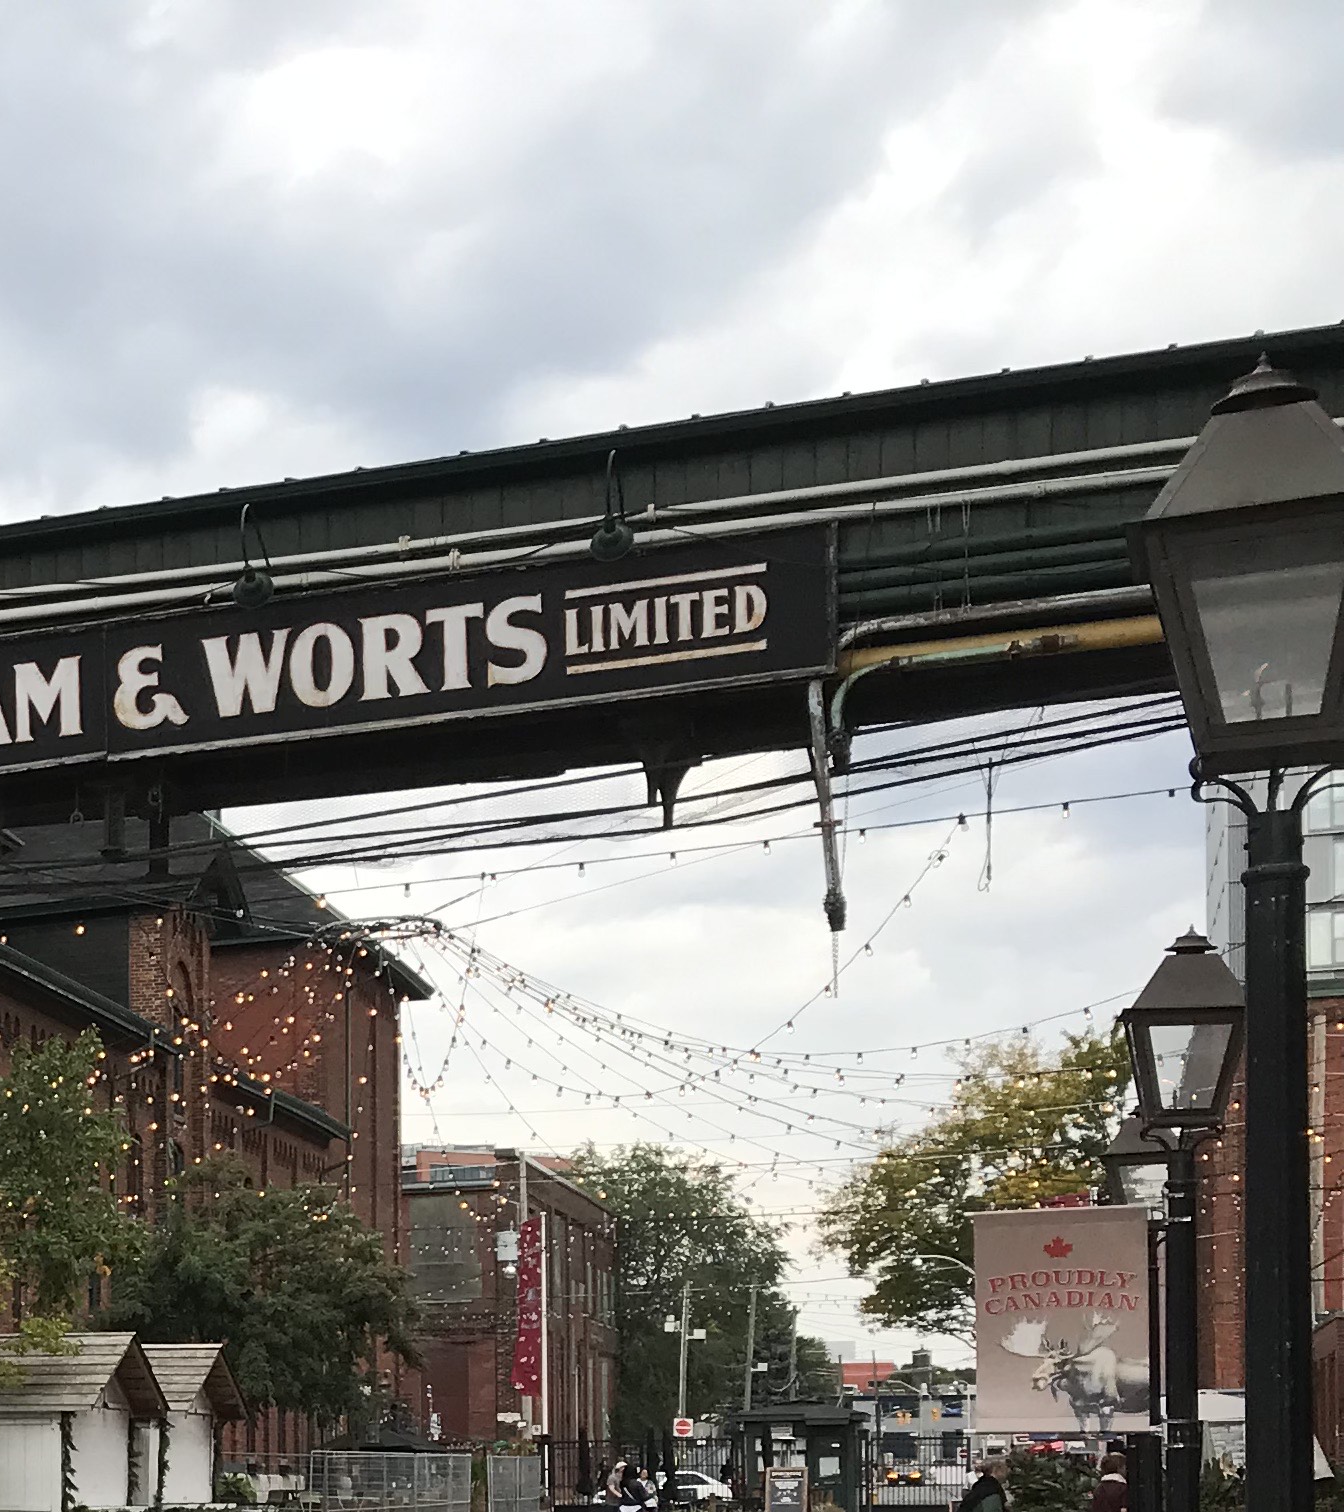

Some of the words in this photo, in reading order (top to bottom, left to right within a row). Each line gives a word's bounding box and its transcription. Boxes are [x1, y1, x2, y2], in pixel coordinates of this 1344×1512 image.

[113, 644, 189, 730] &
[201, 593, 548, 718] WORTS
[563, 584, 767, 656] LIMITED
[988, 1269, 1138, 1293] PROUDLY
[984, 1290, 1140, 1315] CANADIAN
